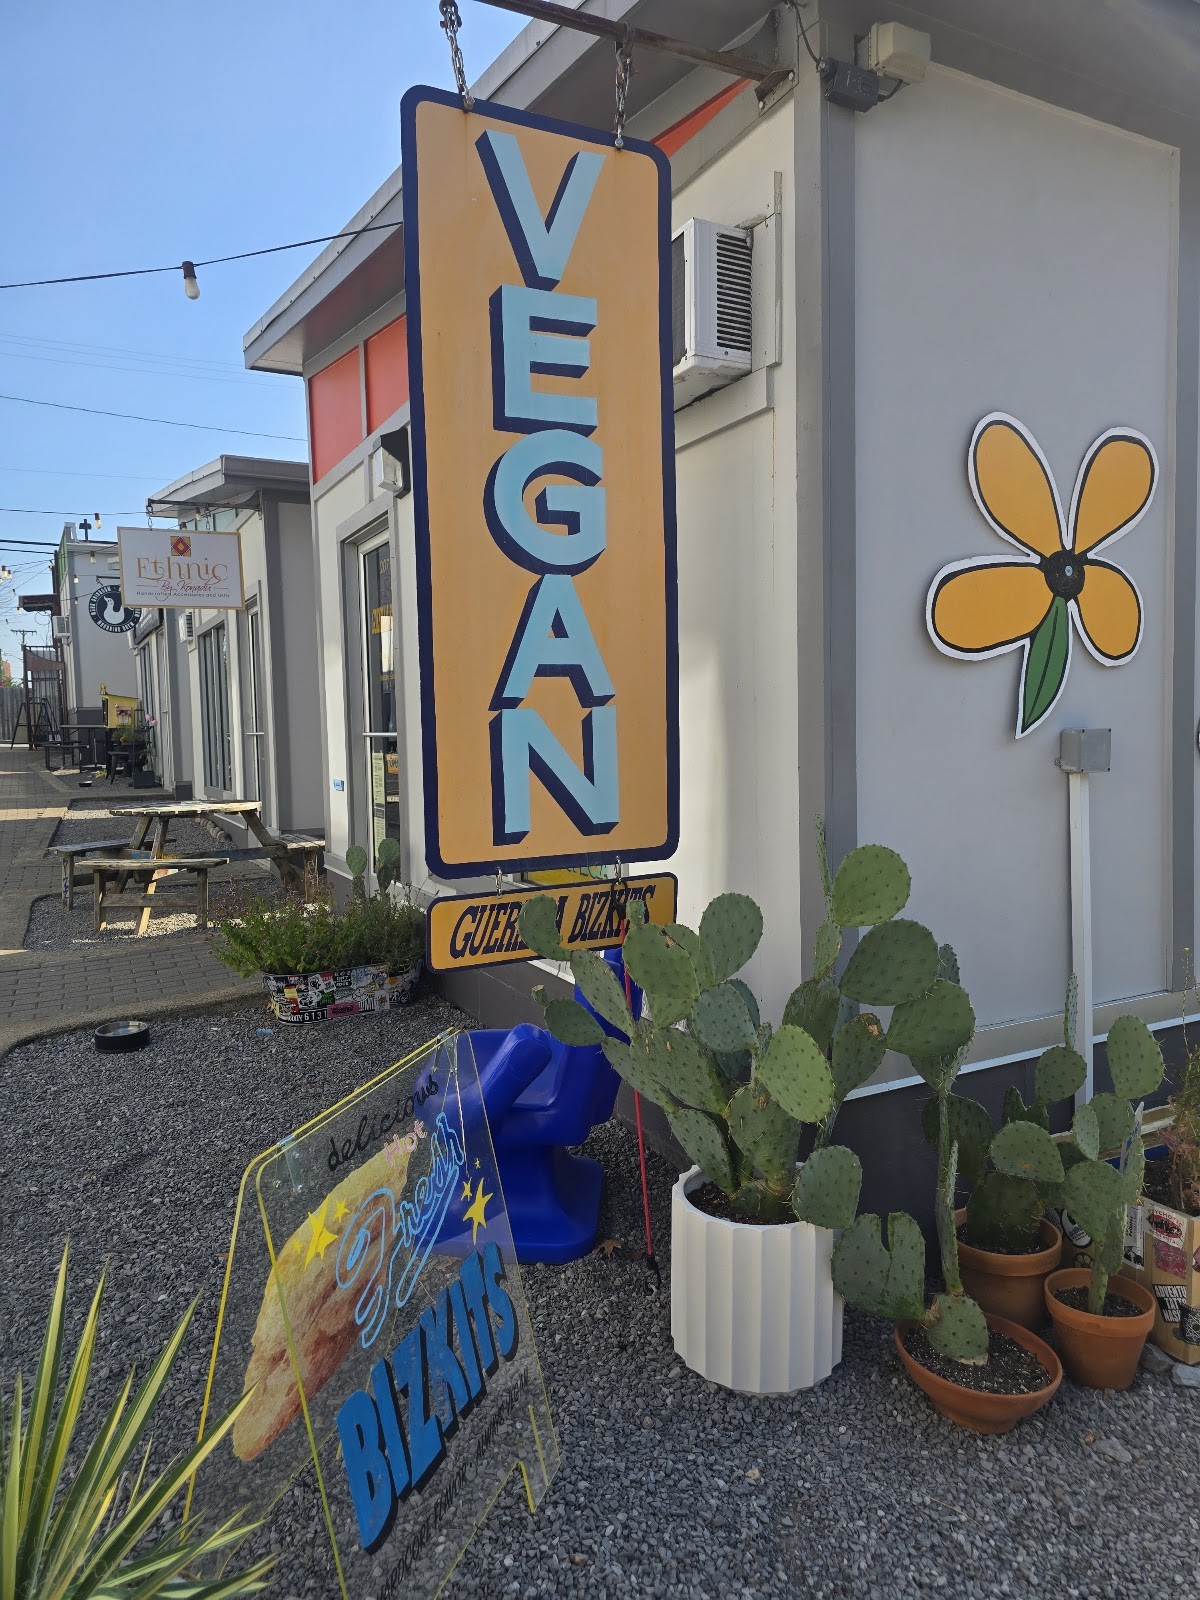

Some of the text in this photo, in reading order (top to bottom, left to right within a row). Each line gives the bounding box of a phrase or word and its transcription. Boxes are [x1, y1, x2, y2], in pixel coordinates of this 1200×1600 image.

[136, 556, 228, 581] Ethnic
[475, 129, 620, 847] VEGAN
[327, 1075, 440, 1172] delicious
[383, 1120, 428, 1167] Hot
[335, 1112, 465, 1349] Fresh
[336, 1240, 520, 1554] BIZKITS
